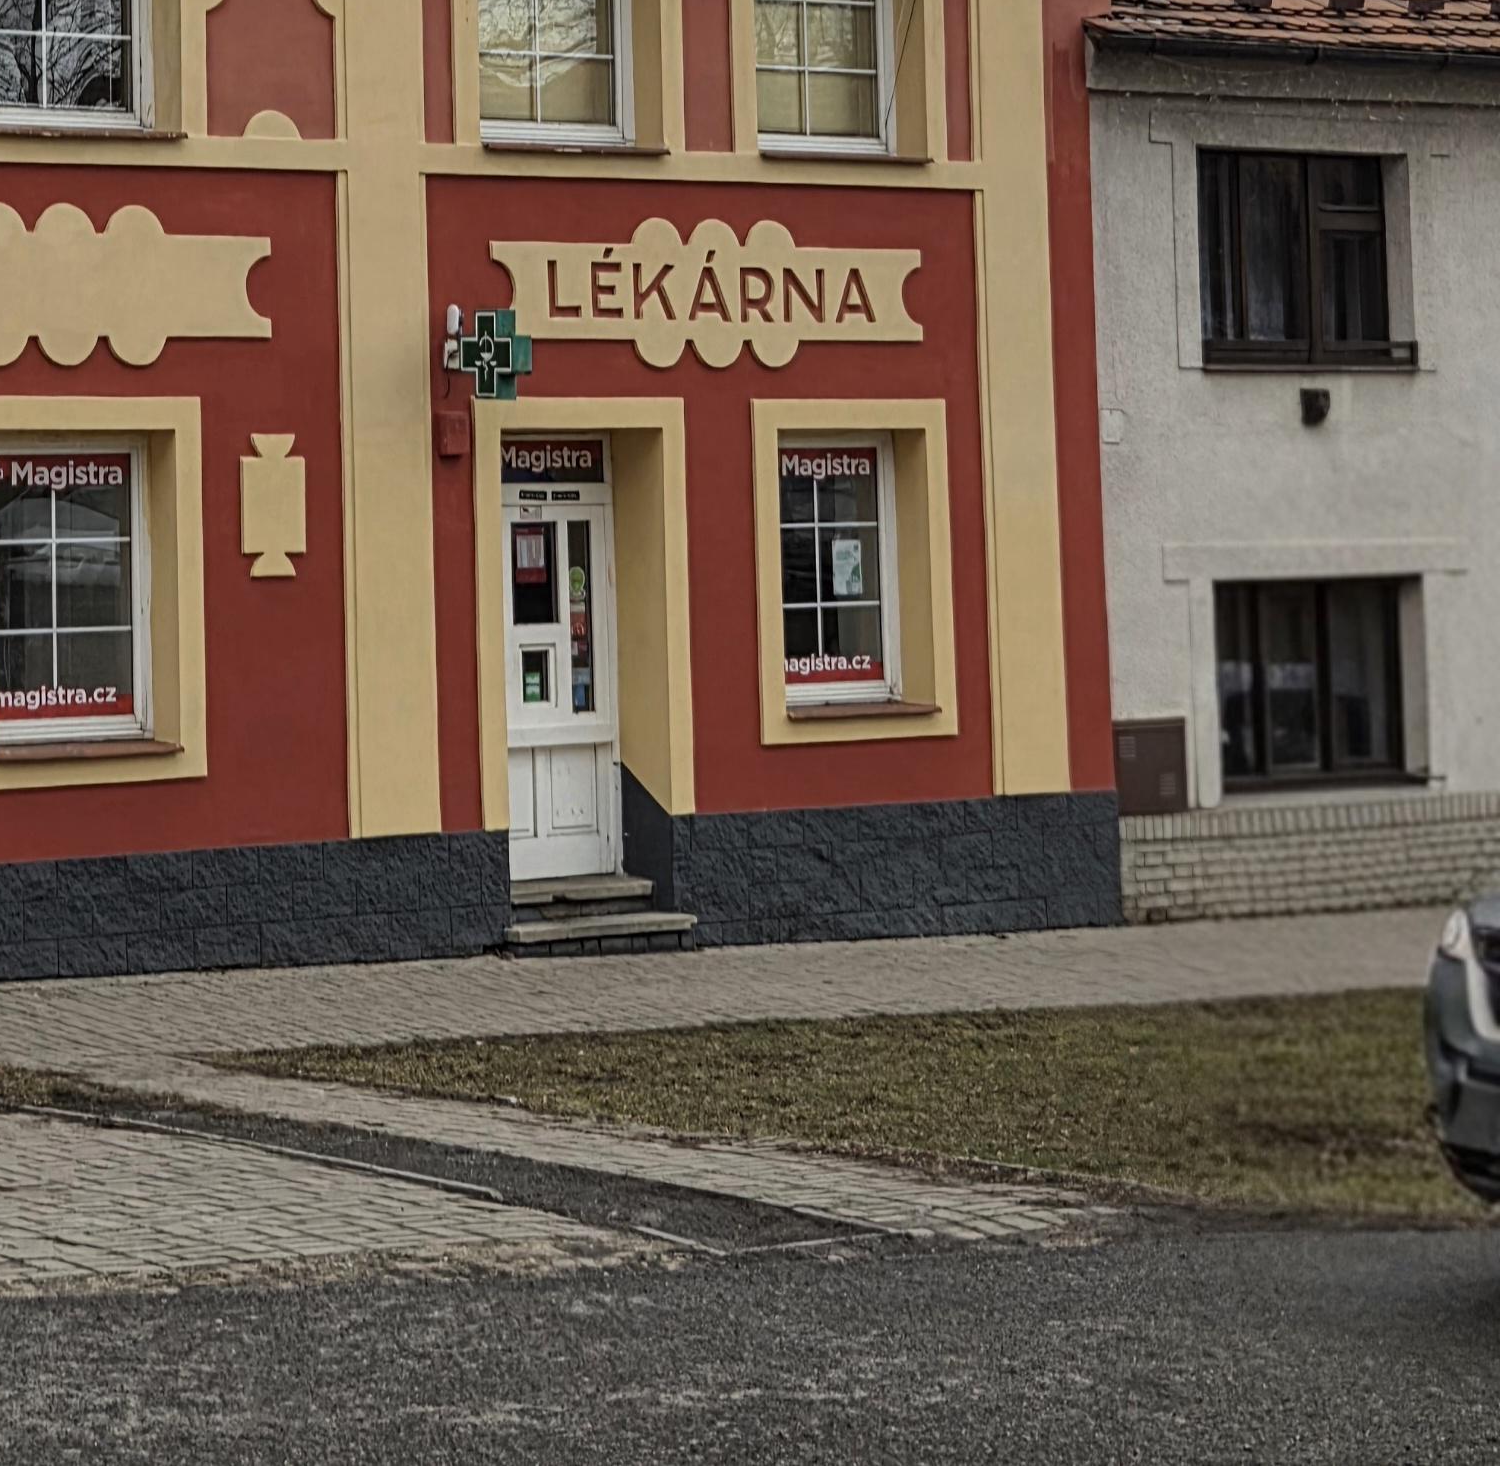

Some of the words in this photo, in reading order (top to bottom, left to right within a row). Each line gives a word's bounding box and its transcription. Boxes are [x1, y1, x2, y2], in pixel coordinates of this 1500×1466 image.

[547, 247, 877, 323] LÉKÁRNA
[501, 445, 592, 473] Magistra
[782, 453, 870, 480] Magistra
[11, 460, 123, 490] Magistra
